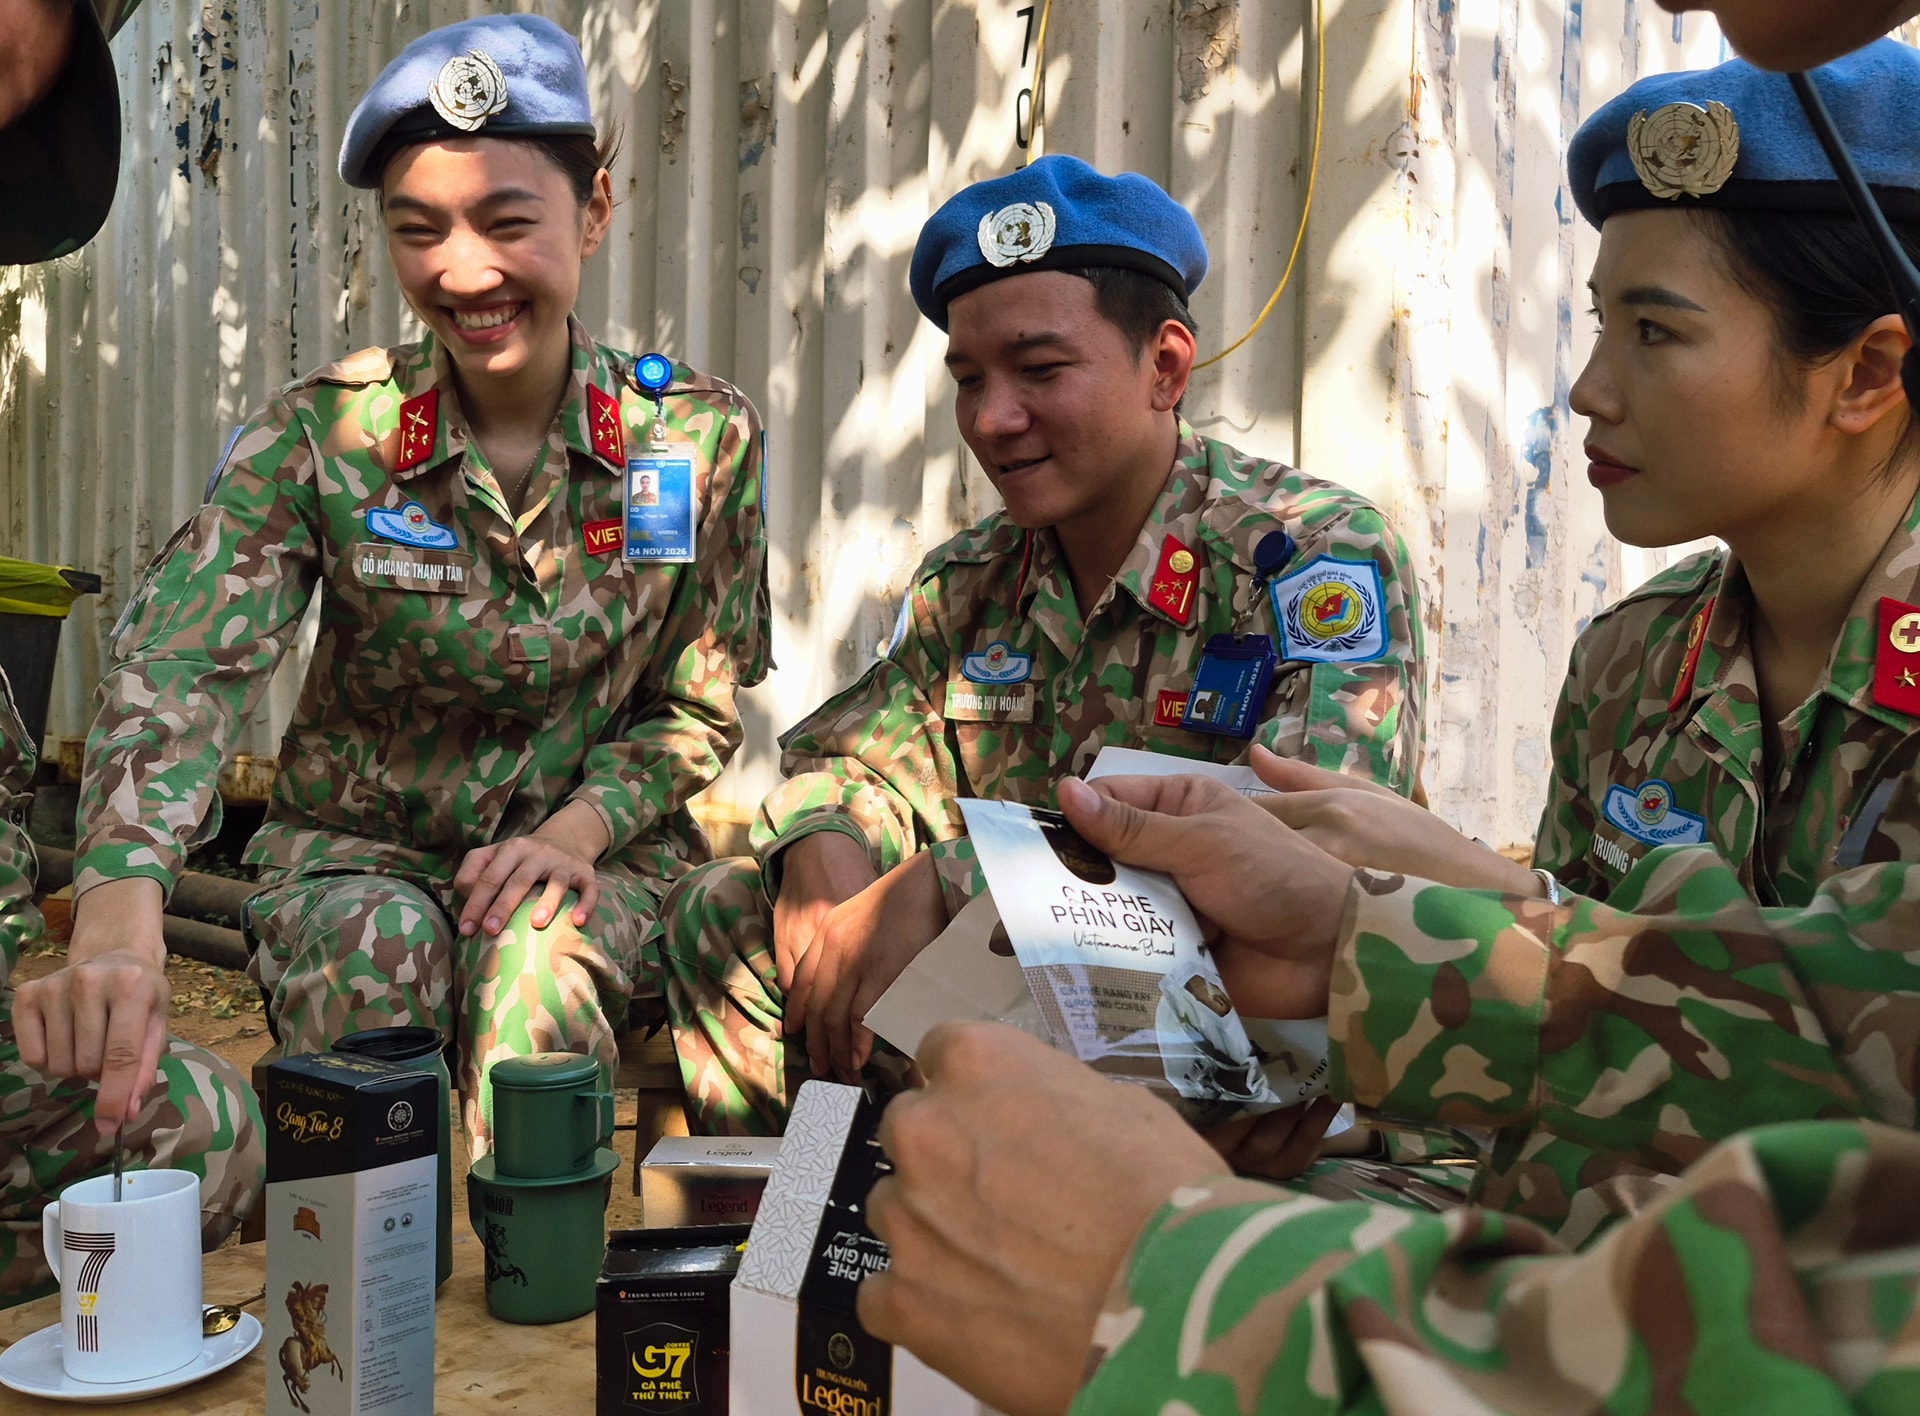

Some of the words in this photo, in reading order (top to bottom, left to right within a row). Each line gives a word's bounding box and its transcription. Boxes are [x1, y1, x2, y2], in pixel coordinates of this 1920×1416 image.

[628, 547, 640, 555] 24
[642, 547, 662, 555] NOV
[664, 547, 687, 555] 2026
[412, 562, 443, 580] THANH
[1248, 661, 1261, 686] 2026
[1161, 698, 1186, 718] VIE
[1240, 688, 1252, 712] NOV
[1236, 714, 1245, 727] 24
[1050, 905, 1117, 929] PHIN
[1138, 938, 1175, 957] Blend
[329, 1116, 344, 1140] 8
[706, 1149, 753, 1157] Legend
[701, 1199, 748, 1215] Legend
[860, 1251, 891, 1272] HIN
[632, 1343, 691, 1378] G7
[641, 1380, 656, 1390] CÀ
[803, 1372, 882, 1416] Legend
